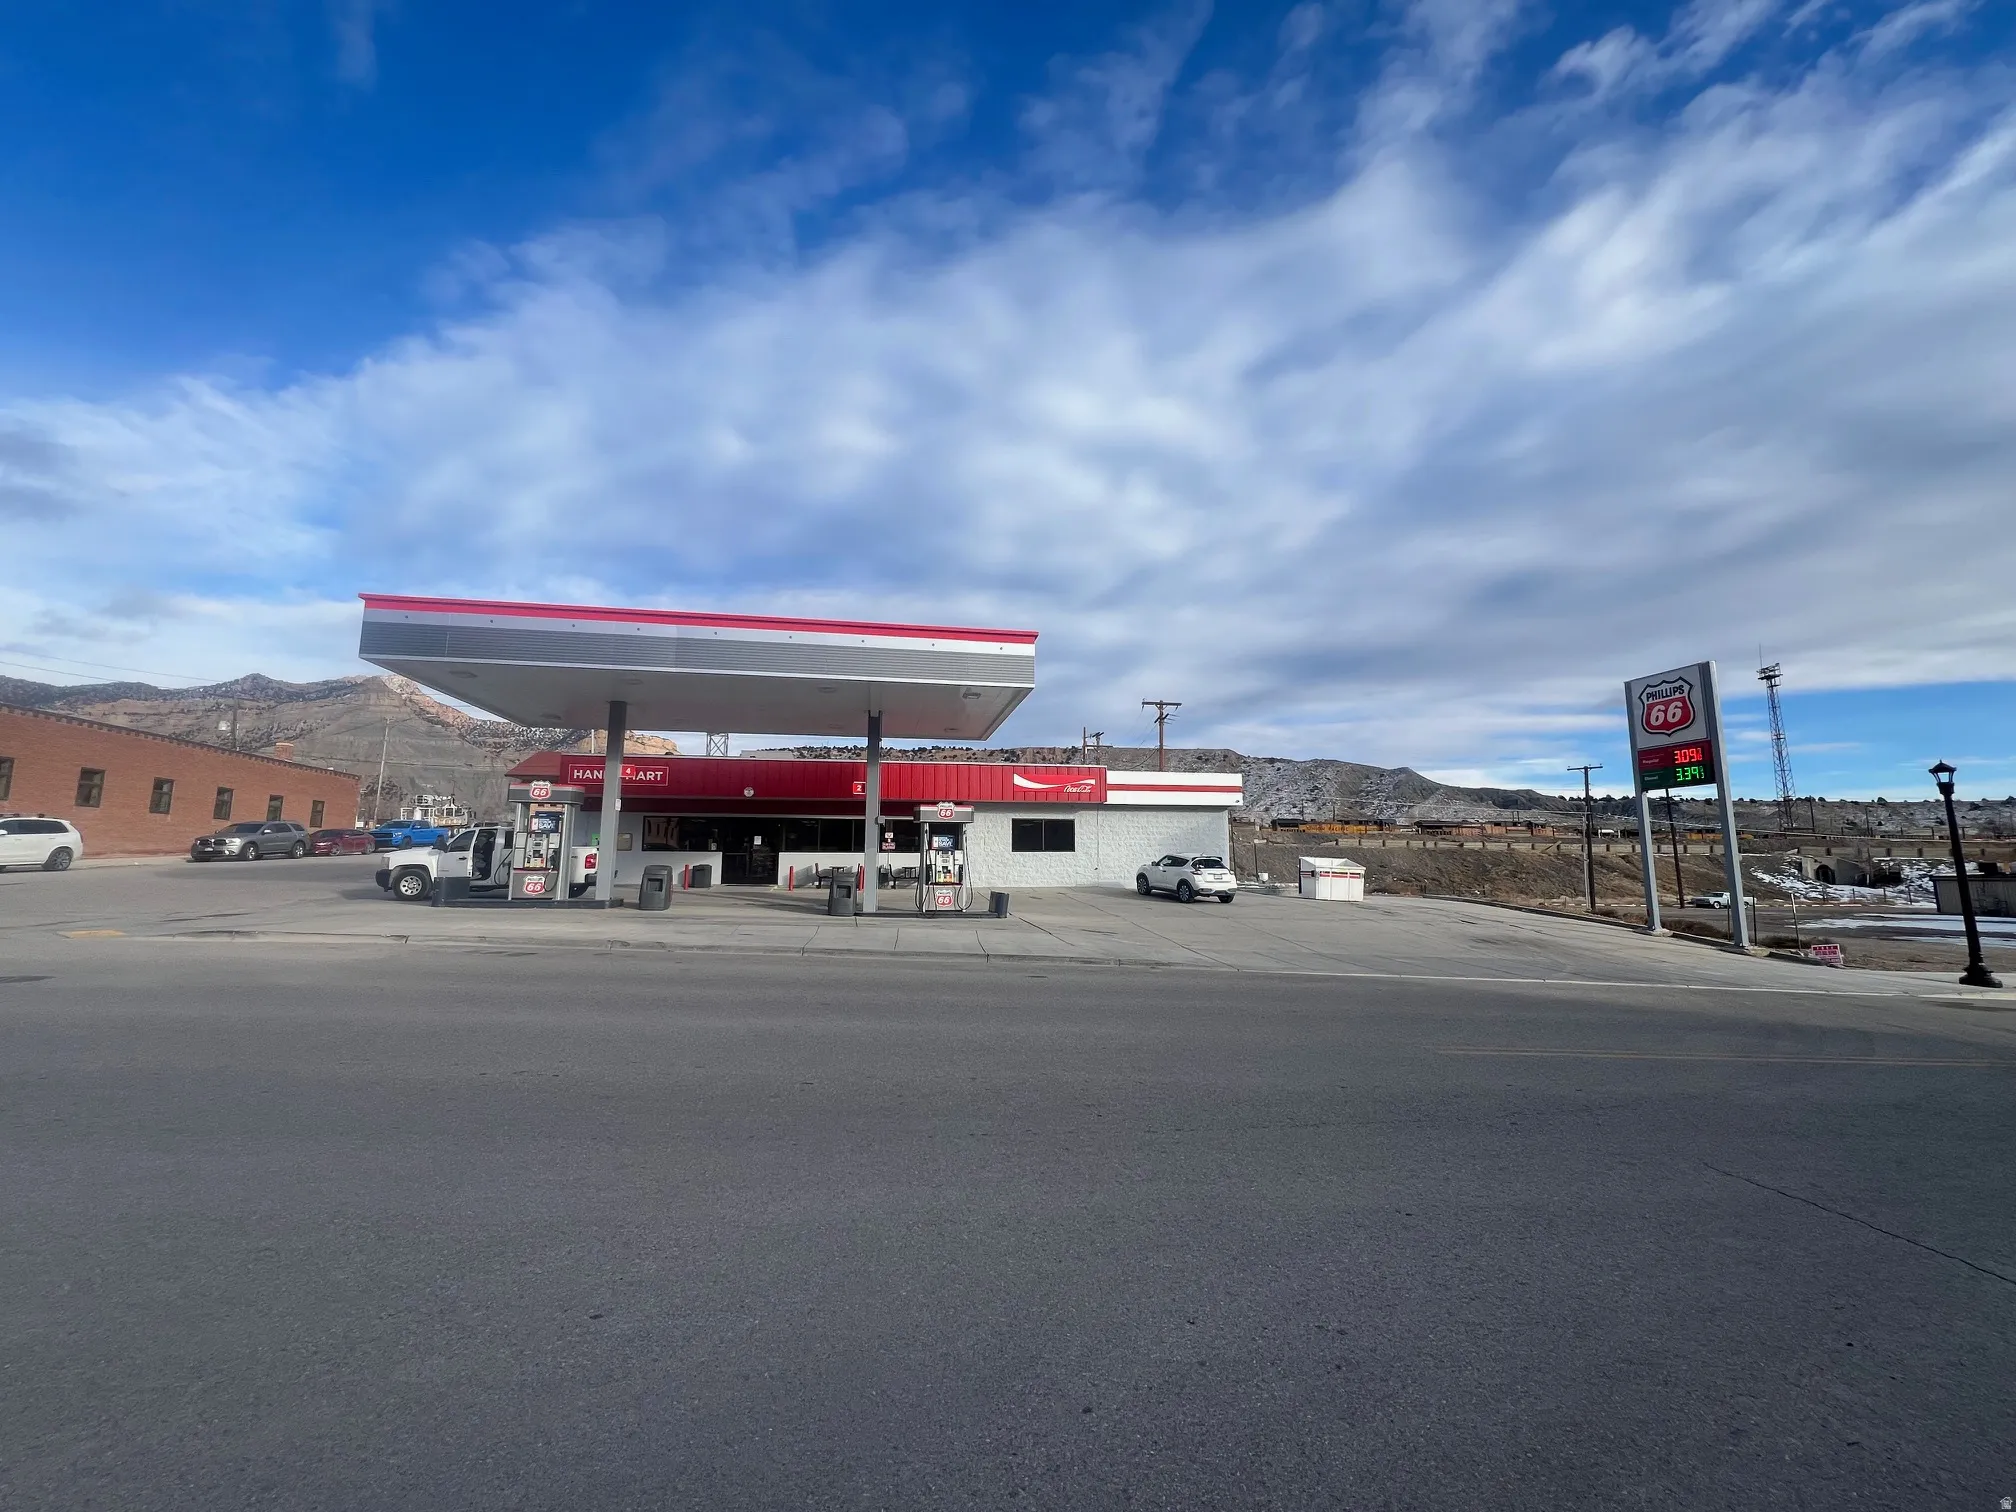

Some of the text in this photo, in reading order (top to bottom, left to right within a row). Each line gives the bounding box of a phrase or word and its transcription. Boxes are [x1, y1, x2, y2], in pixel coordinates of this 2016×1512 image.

[1646, 685, 1684, 702] PHILLIPS
[1650, 702, 1682, 726] 66
[856, 784, 863, 792] 2
[940, 809, 952, 817] 66
[527, 883, 542, 891] 66
[938, 896, 950, 904] 66
